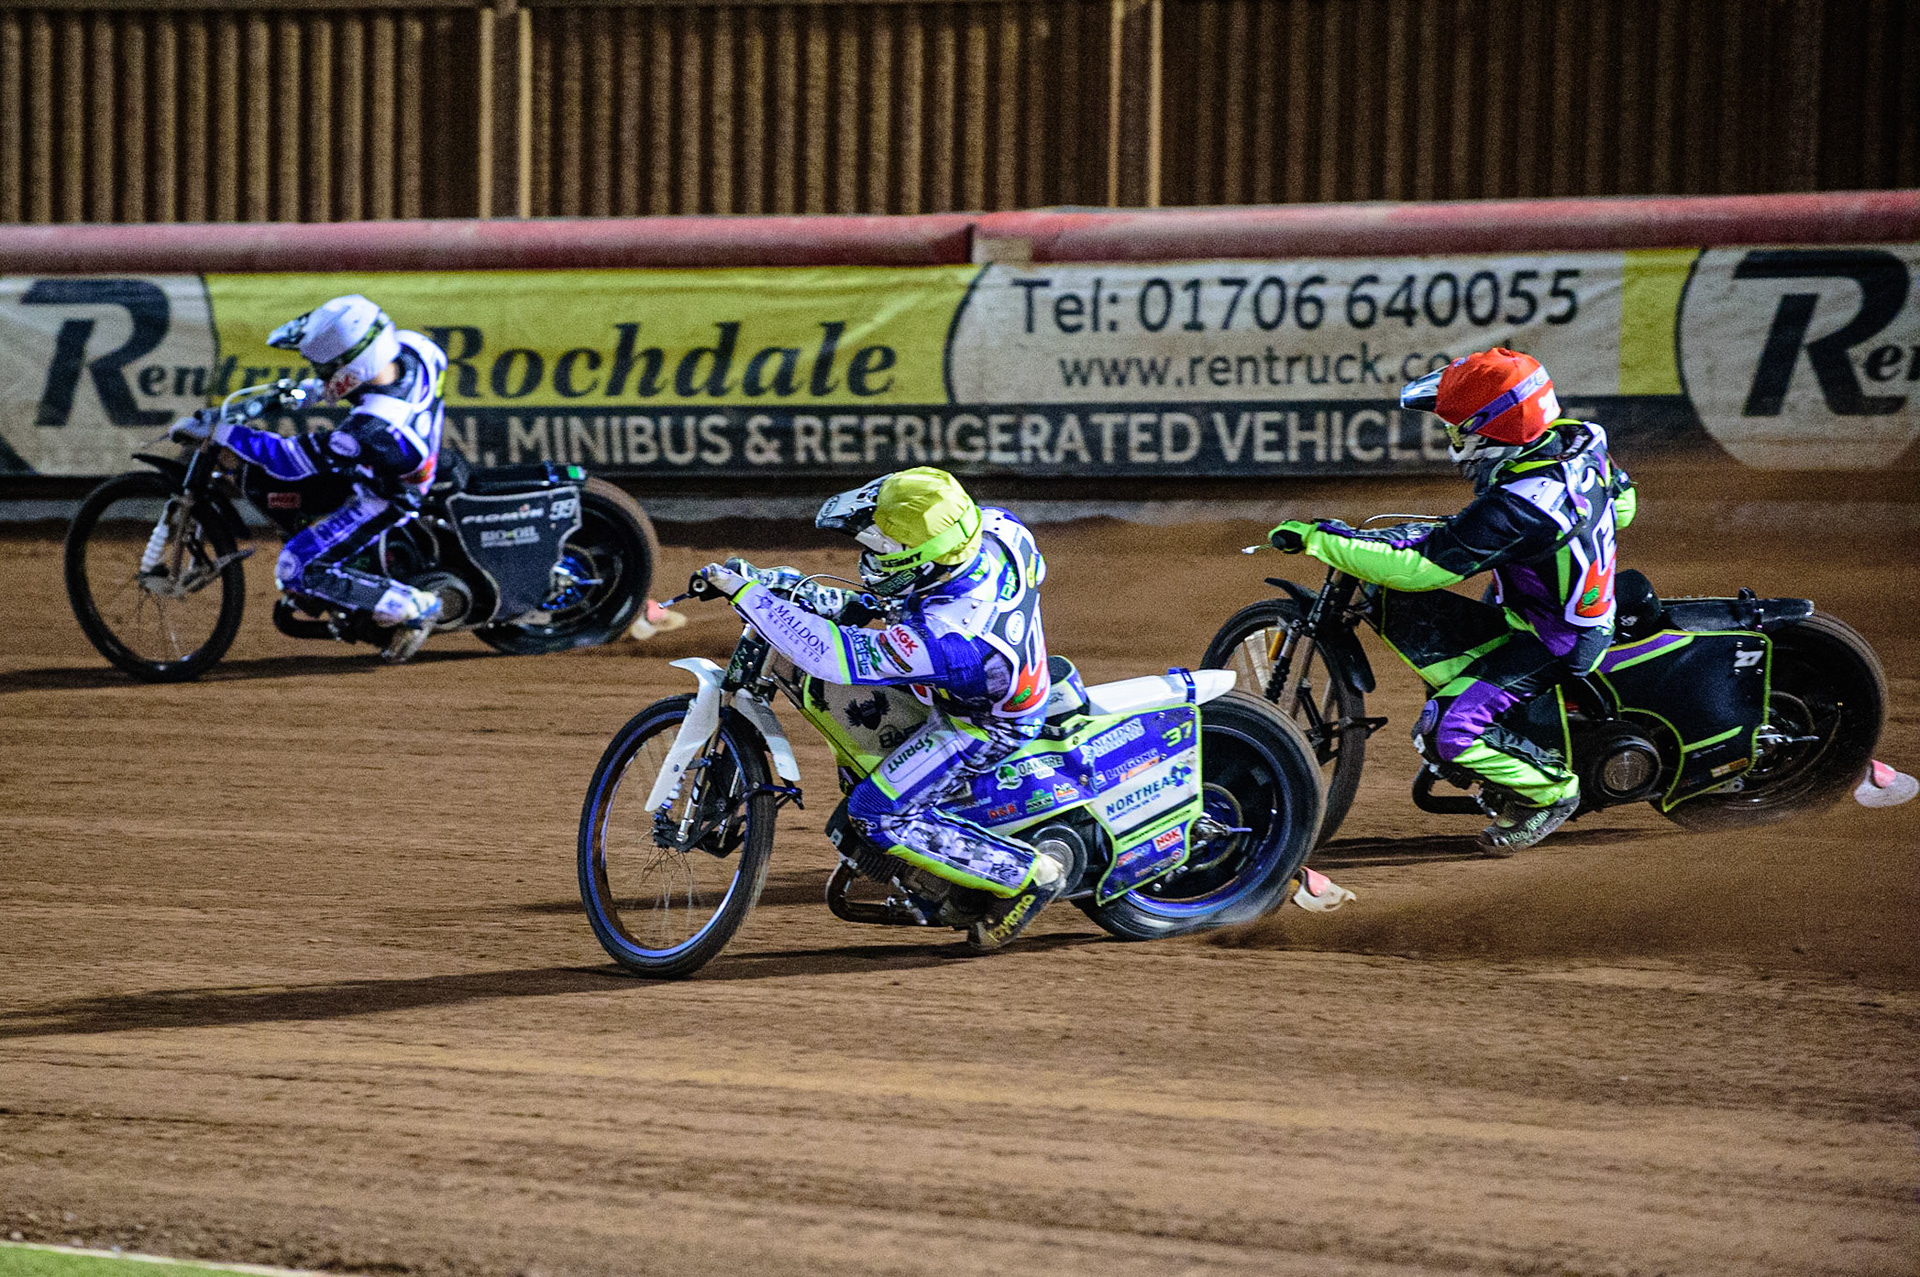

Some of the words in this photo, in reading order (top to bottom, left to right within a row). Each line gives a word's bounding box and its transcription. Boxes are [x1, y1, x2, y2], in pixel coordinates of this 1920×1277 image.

[1012, 278, 1118, 334] Tel:
[1138, 276, 1326, 331] 01706
[1346, 269, 1581, 328] 640055
[420, 321, 897, 401] Rochdale
[508, 414, 730, 465] MINIBUS
[744, 414, 784, 465] &
[795, 411, 1200, 465] REFRIGERATED
[767, 611, 799, 645] METALS
[803, 648, 821, 663] LTD
[775, 604, 830, 655] MALDON
[892, 626, 919, 654] NGK
[887, 732, 935, 775] SPRINT
[1161, 720, 1193, 748] 37
[1155, 827, 1181, 846] NGK
